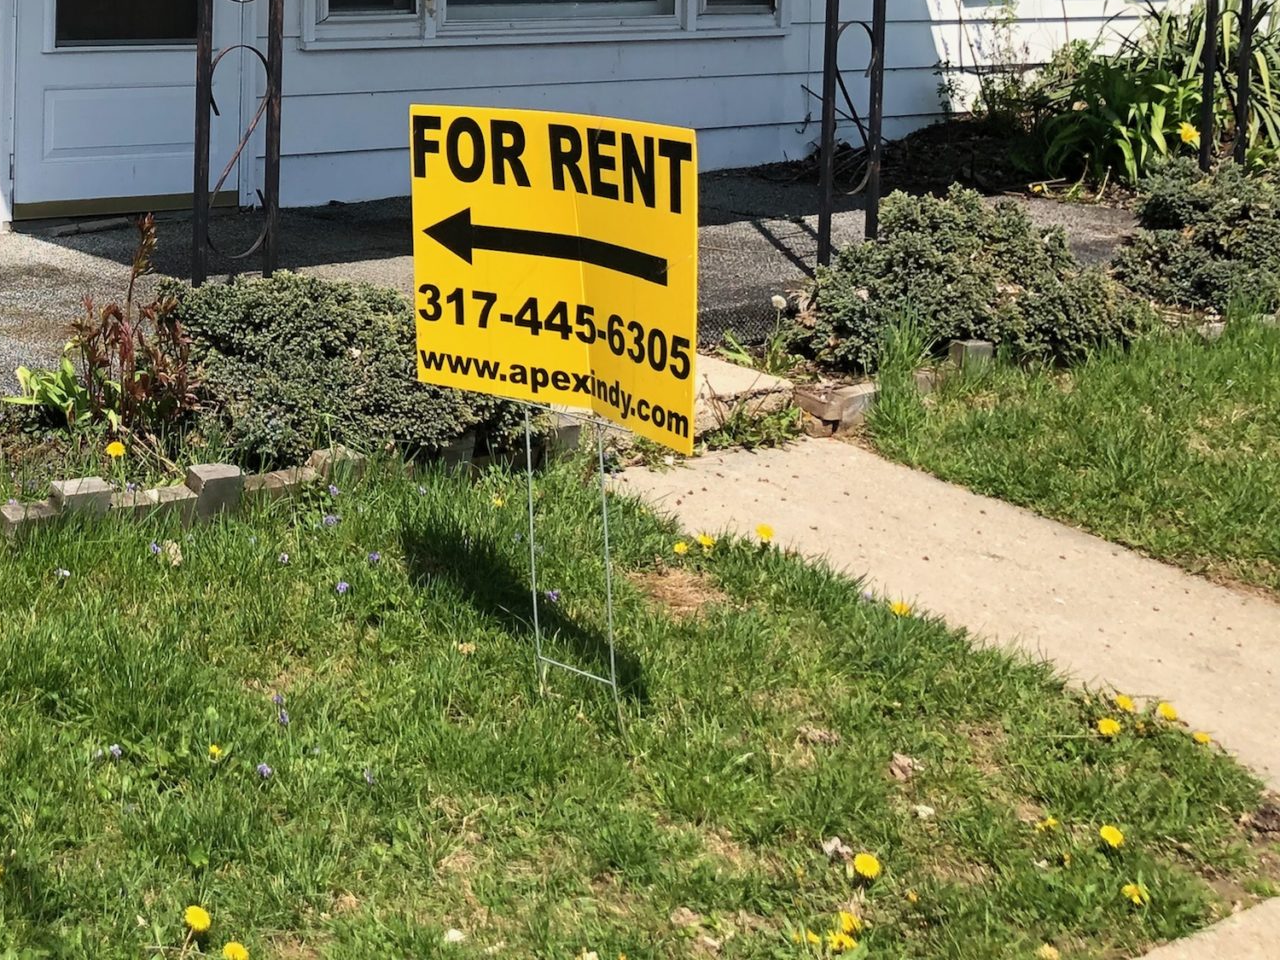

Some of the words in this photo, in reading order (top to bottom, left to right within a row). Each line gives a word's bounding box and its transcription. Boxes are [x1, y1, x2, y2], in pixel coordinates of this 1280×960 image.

[412, 115, 531, 187] FOR
[548, 123, 692, 214] RENT
[418, 284, 691, 380] 317-445-6305
[420, 349, 689, 438] www.apexindy.com
